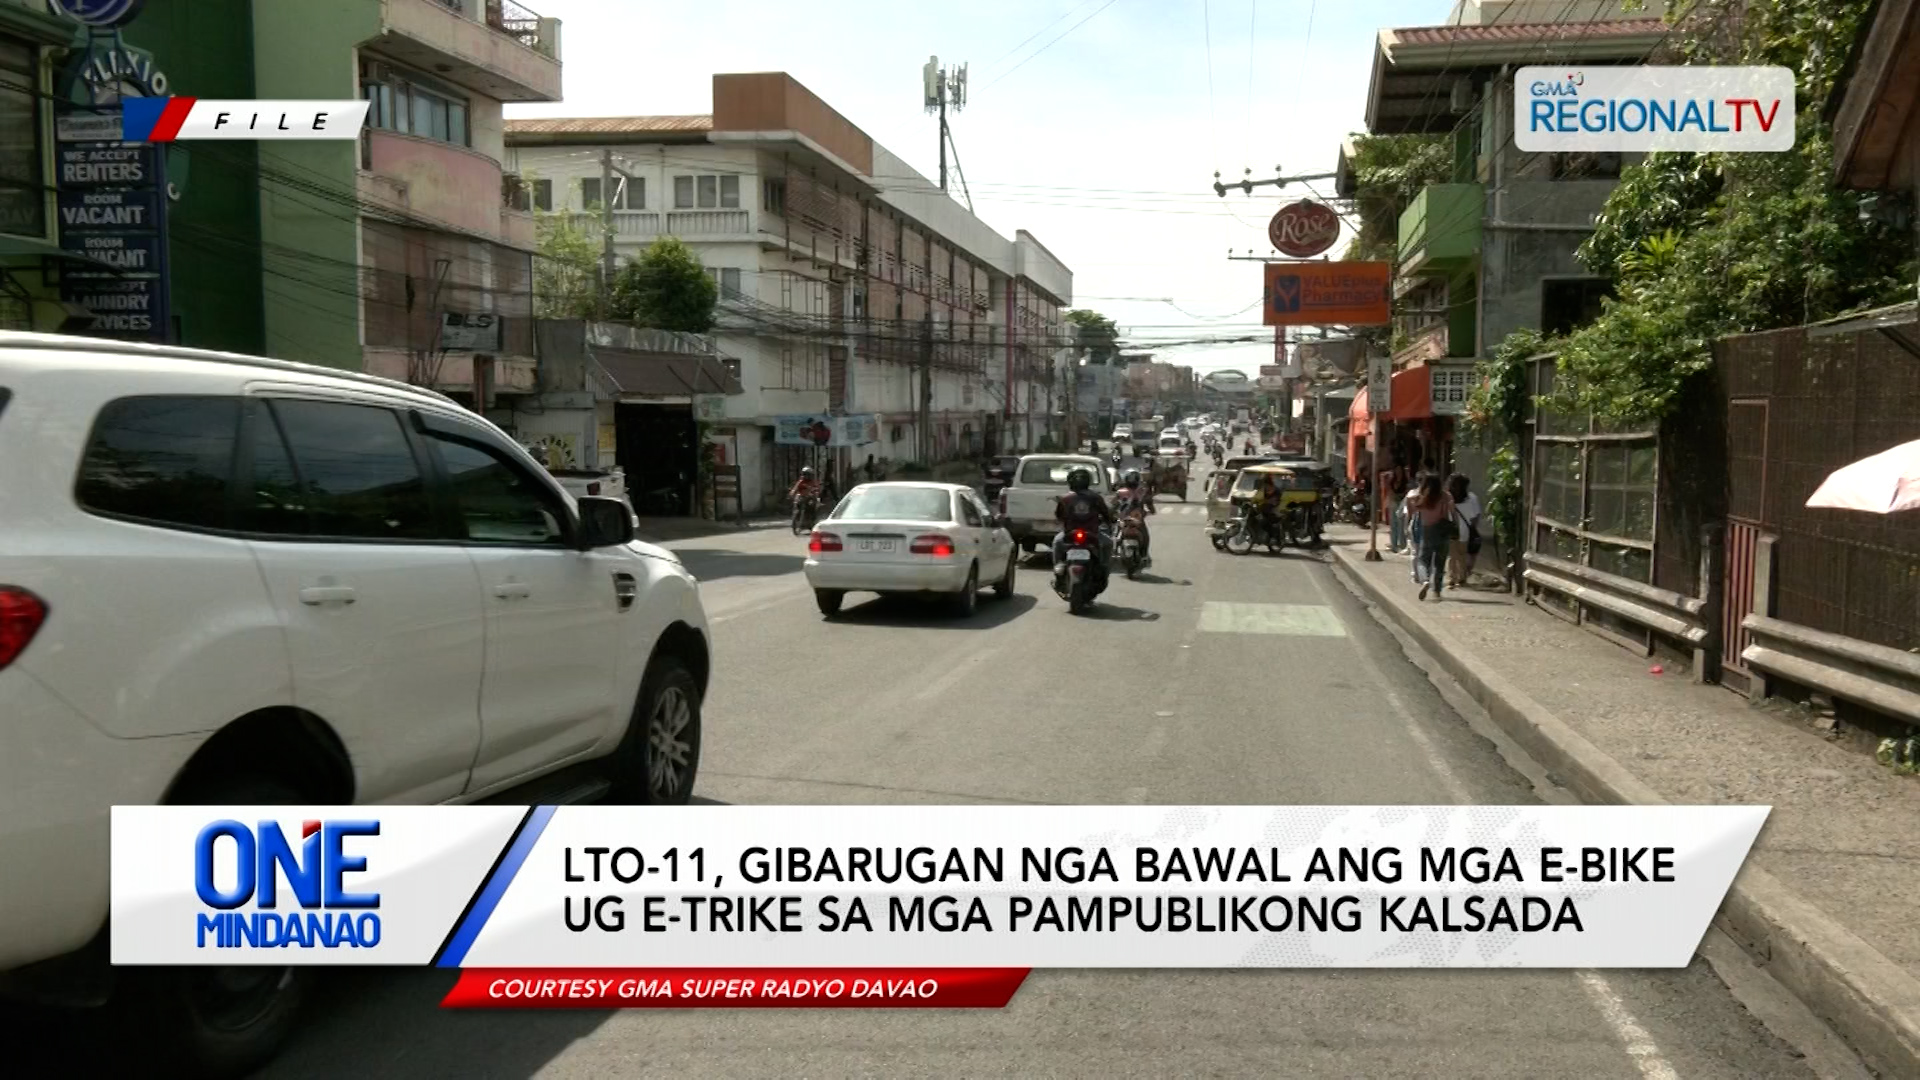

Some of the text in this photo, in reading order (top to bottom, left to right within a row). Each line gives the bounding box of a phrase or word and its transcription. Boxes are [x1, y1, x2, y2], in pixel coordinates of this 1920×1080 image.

[63, 163, 143, 182] RENTERS
[83, 193, 123, 204] ROOM
[62, 205, 145, 224] VACANT
[1276, 213, 1331, 244] Rose
[84, 237, 124, 248] ROOM
[1302, 289, 1379, 304] Pharmacy
